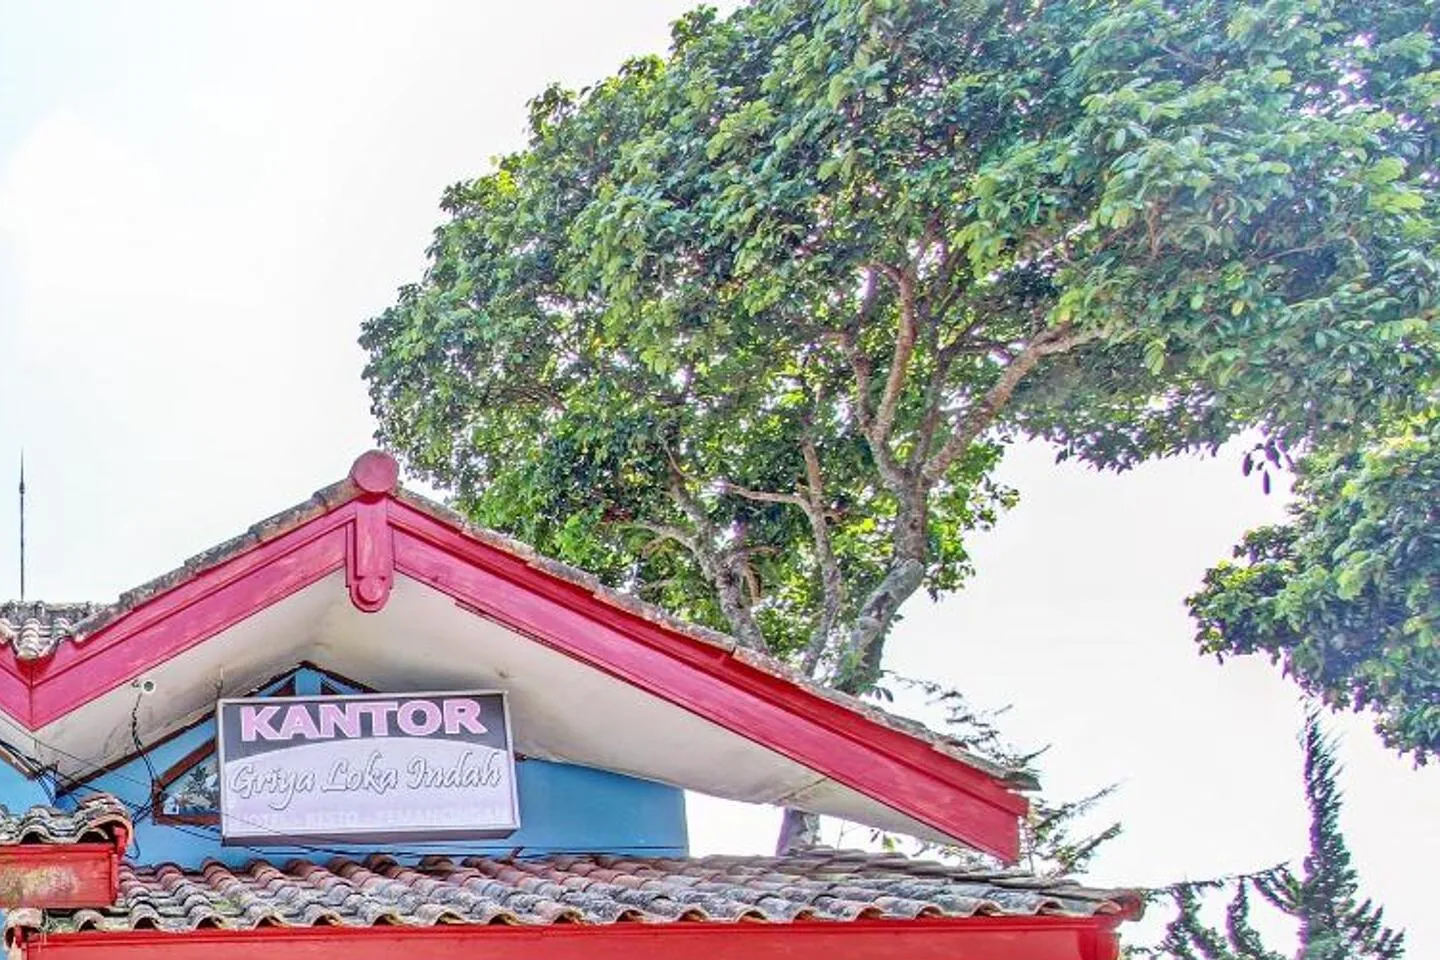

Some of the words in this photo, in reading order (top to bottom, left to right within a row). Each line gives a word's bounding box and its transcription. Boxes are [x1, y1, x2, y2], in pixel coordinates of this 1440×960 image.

[240, 699, 488, 742] KANTOR
[230, 763, 316, 810] Griya
[322, 752, 399, 795] Loka
[406, 751, 502, 789] Indah
